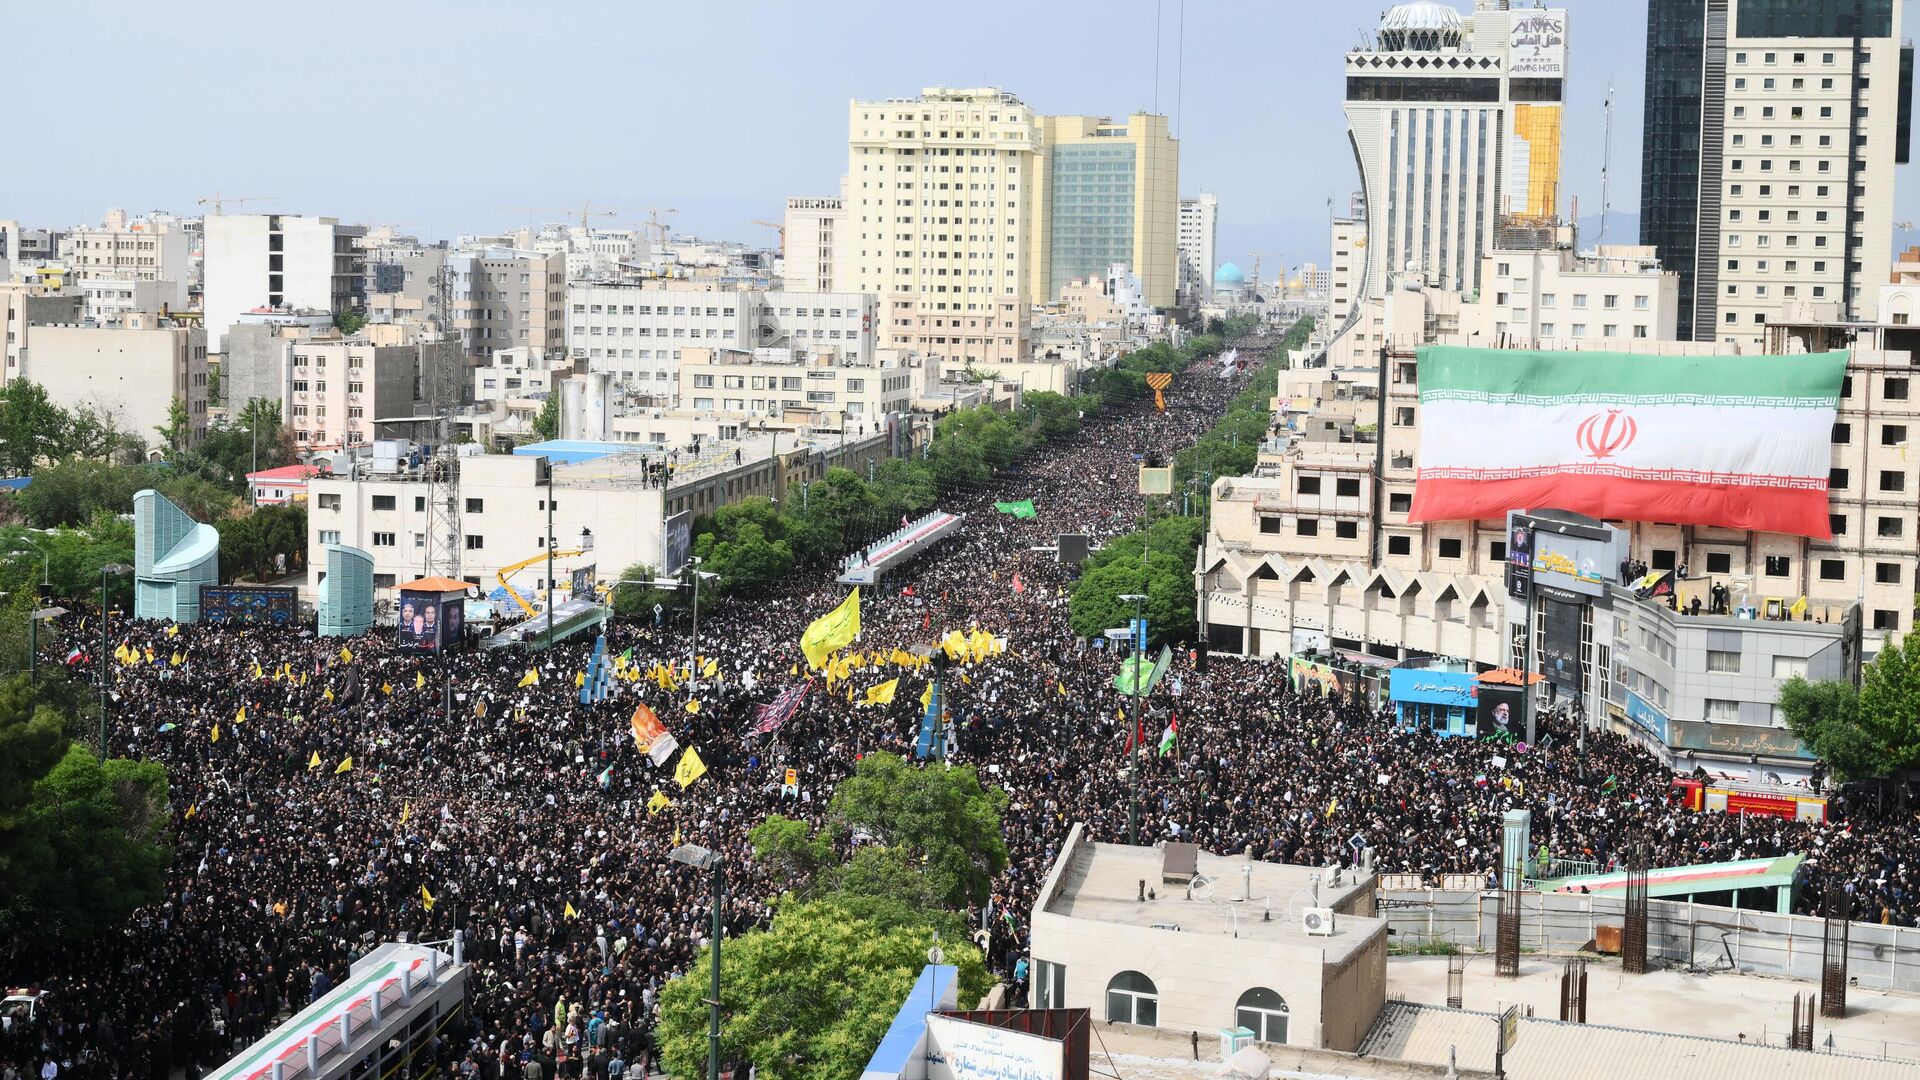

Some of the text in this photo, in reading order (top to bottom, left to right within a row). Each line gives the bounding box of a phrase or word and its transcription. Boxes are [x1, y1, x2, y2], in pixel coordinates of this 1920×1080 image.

[1511, 19, 1562, 33] ALMAS
[1511, 33, 1561, 48] هتل الماس
[1533, 46, 1540, 56] 2
[1510, 64, 1560, 72] ALMAS HOTEL
